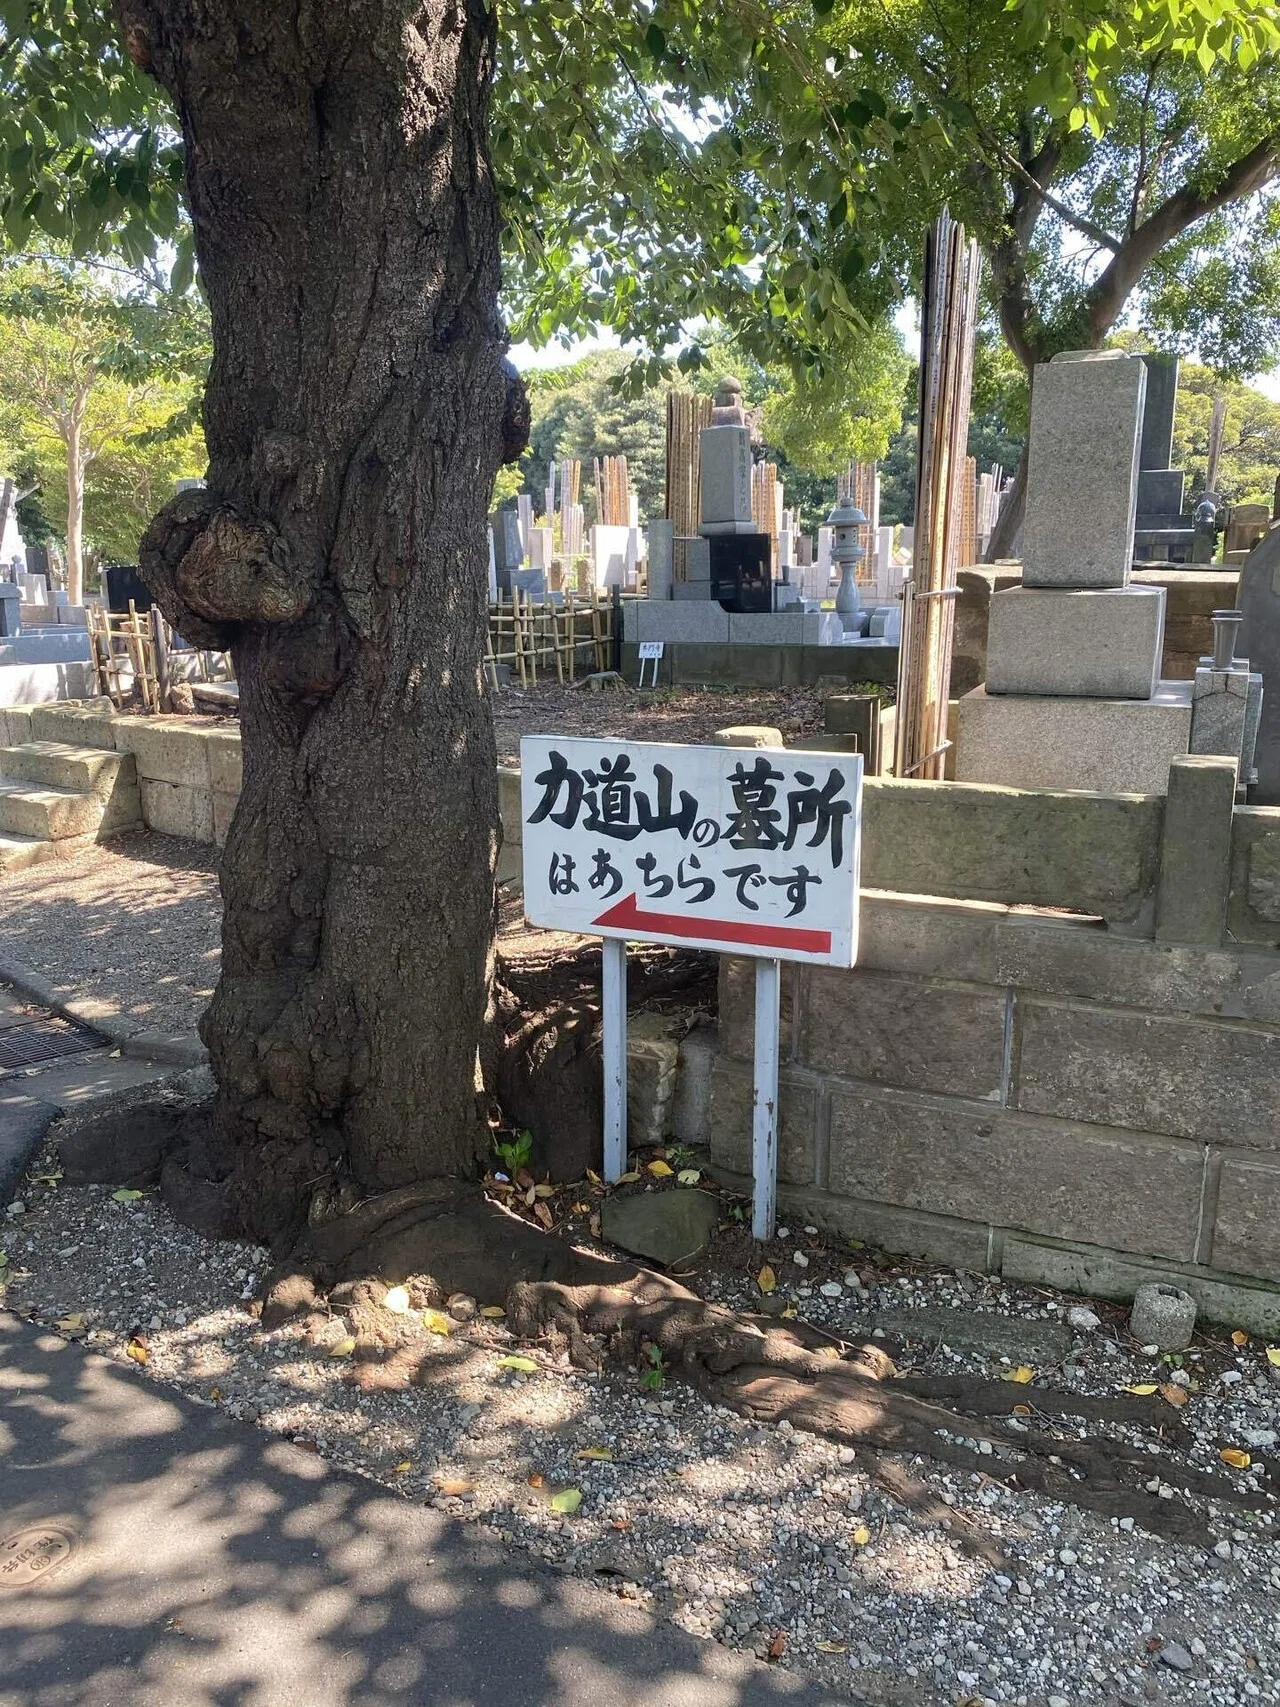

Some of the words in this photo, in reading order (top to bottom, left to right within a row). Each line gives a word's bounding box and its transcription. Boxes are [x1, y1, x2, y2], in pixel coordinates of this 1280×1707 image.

[527, 750, 852, 869] 力道山の墓所
[549, 848, 822, 919] はあちらです
